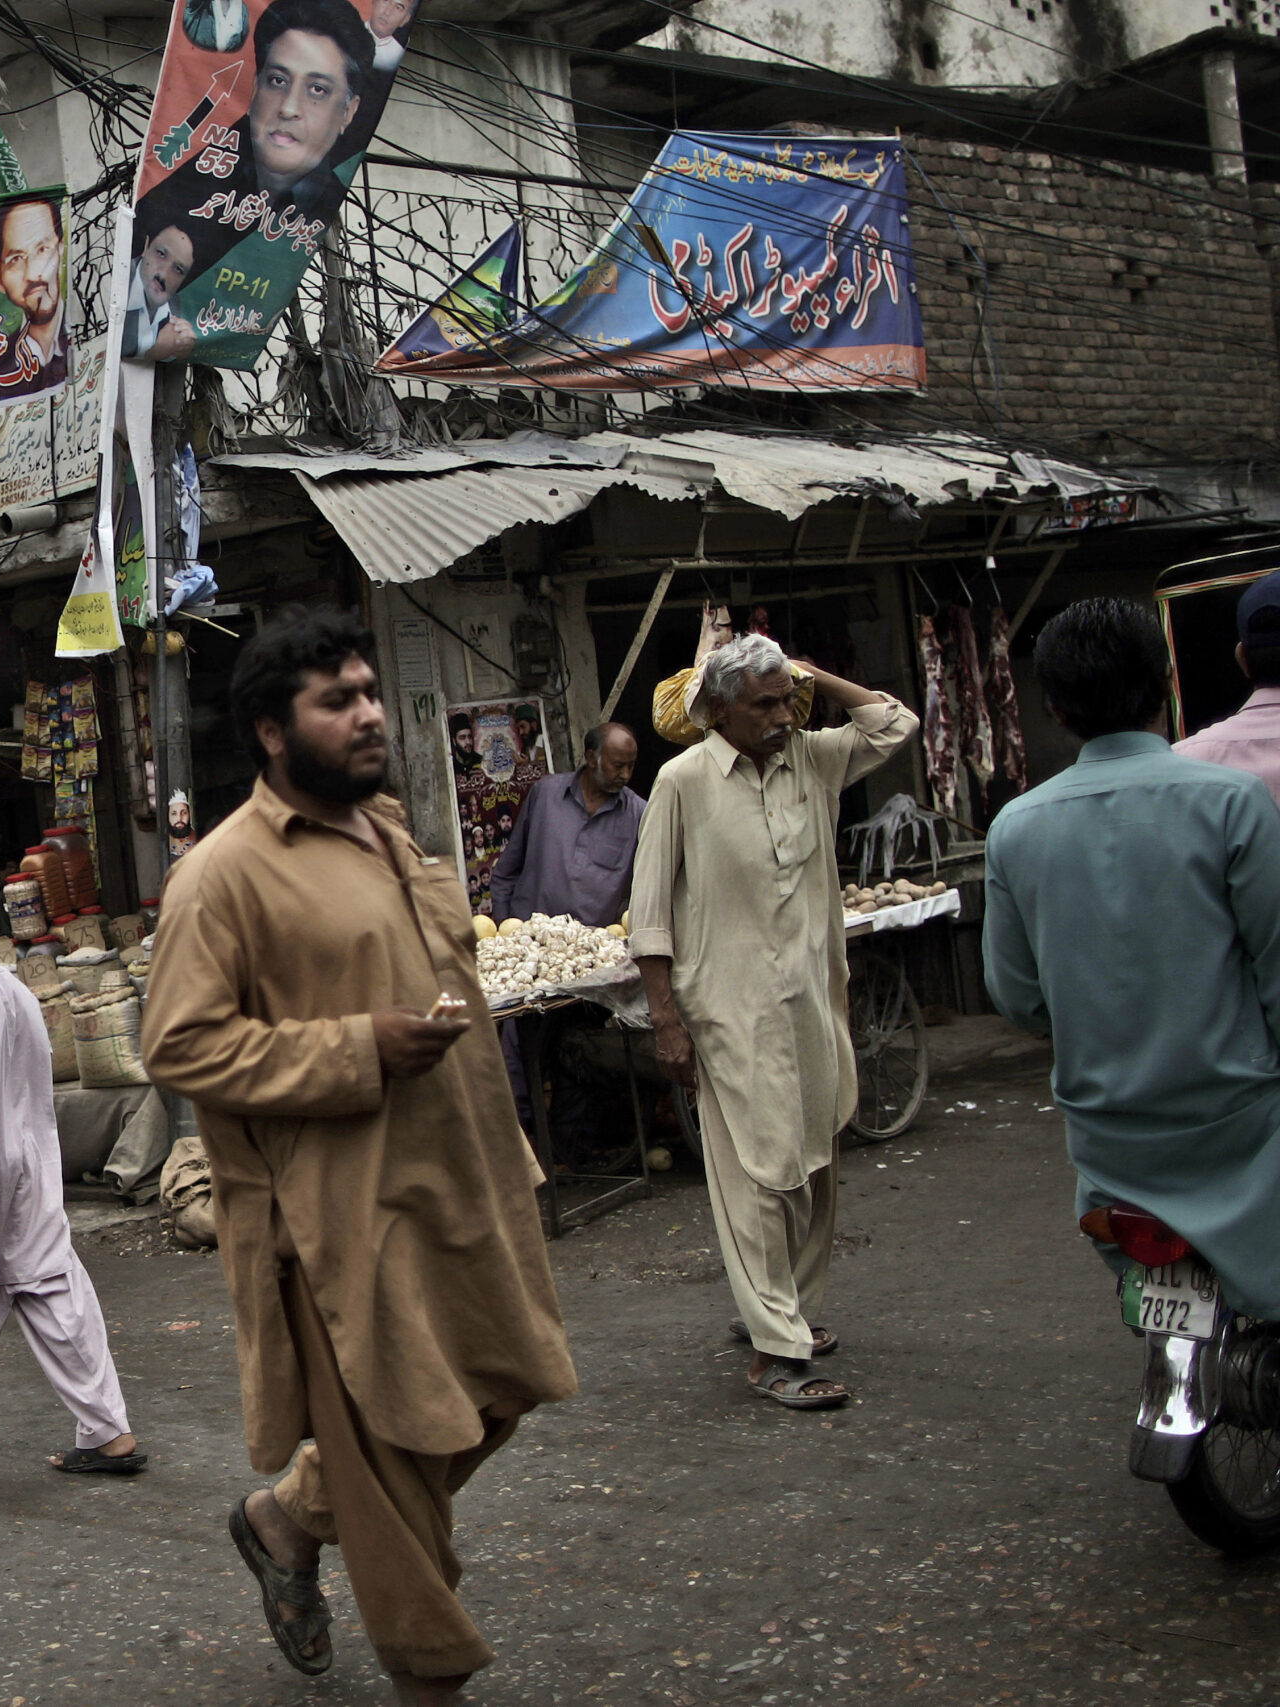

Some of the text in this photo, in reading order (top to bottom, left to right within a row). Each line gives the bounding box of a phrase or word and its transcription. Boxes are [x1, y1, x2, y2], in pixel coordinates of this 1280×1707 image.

[201, 123, 240, 152] NA
[195, 146, 240, 179] 55
[214, 267, 271, 300] PP-11
[73, 923, 97, 949] 75
[114, 926, 136, 947] 90
[1142, 1296, 1191, 1332] 7872
